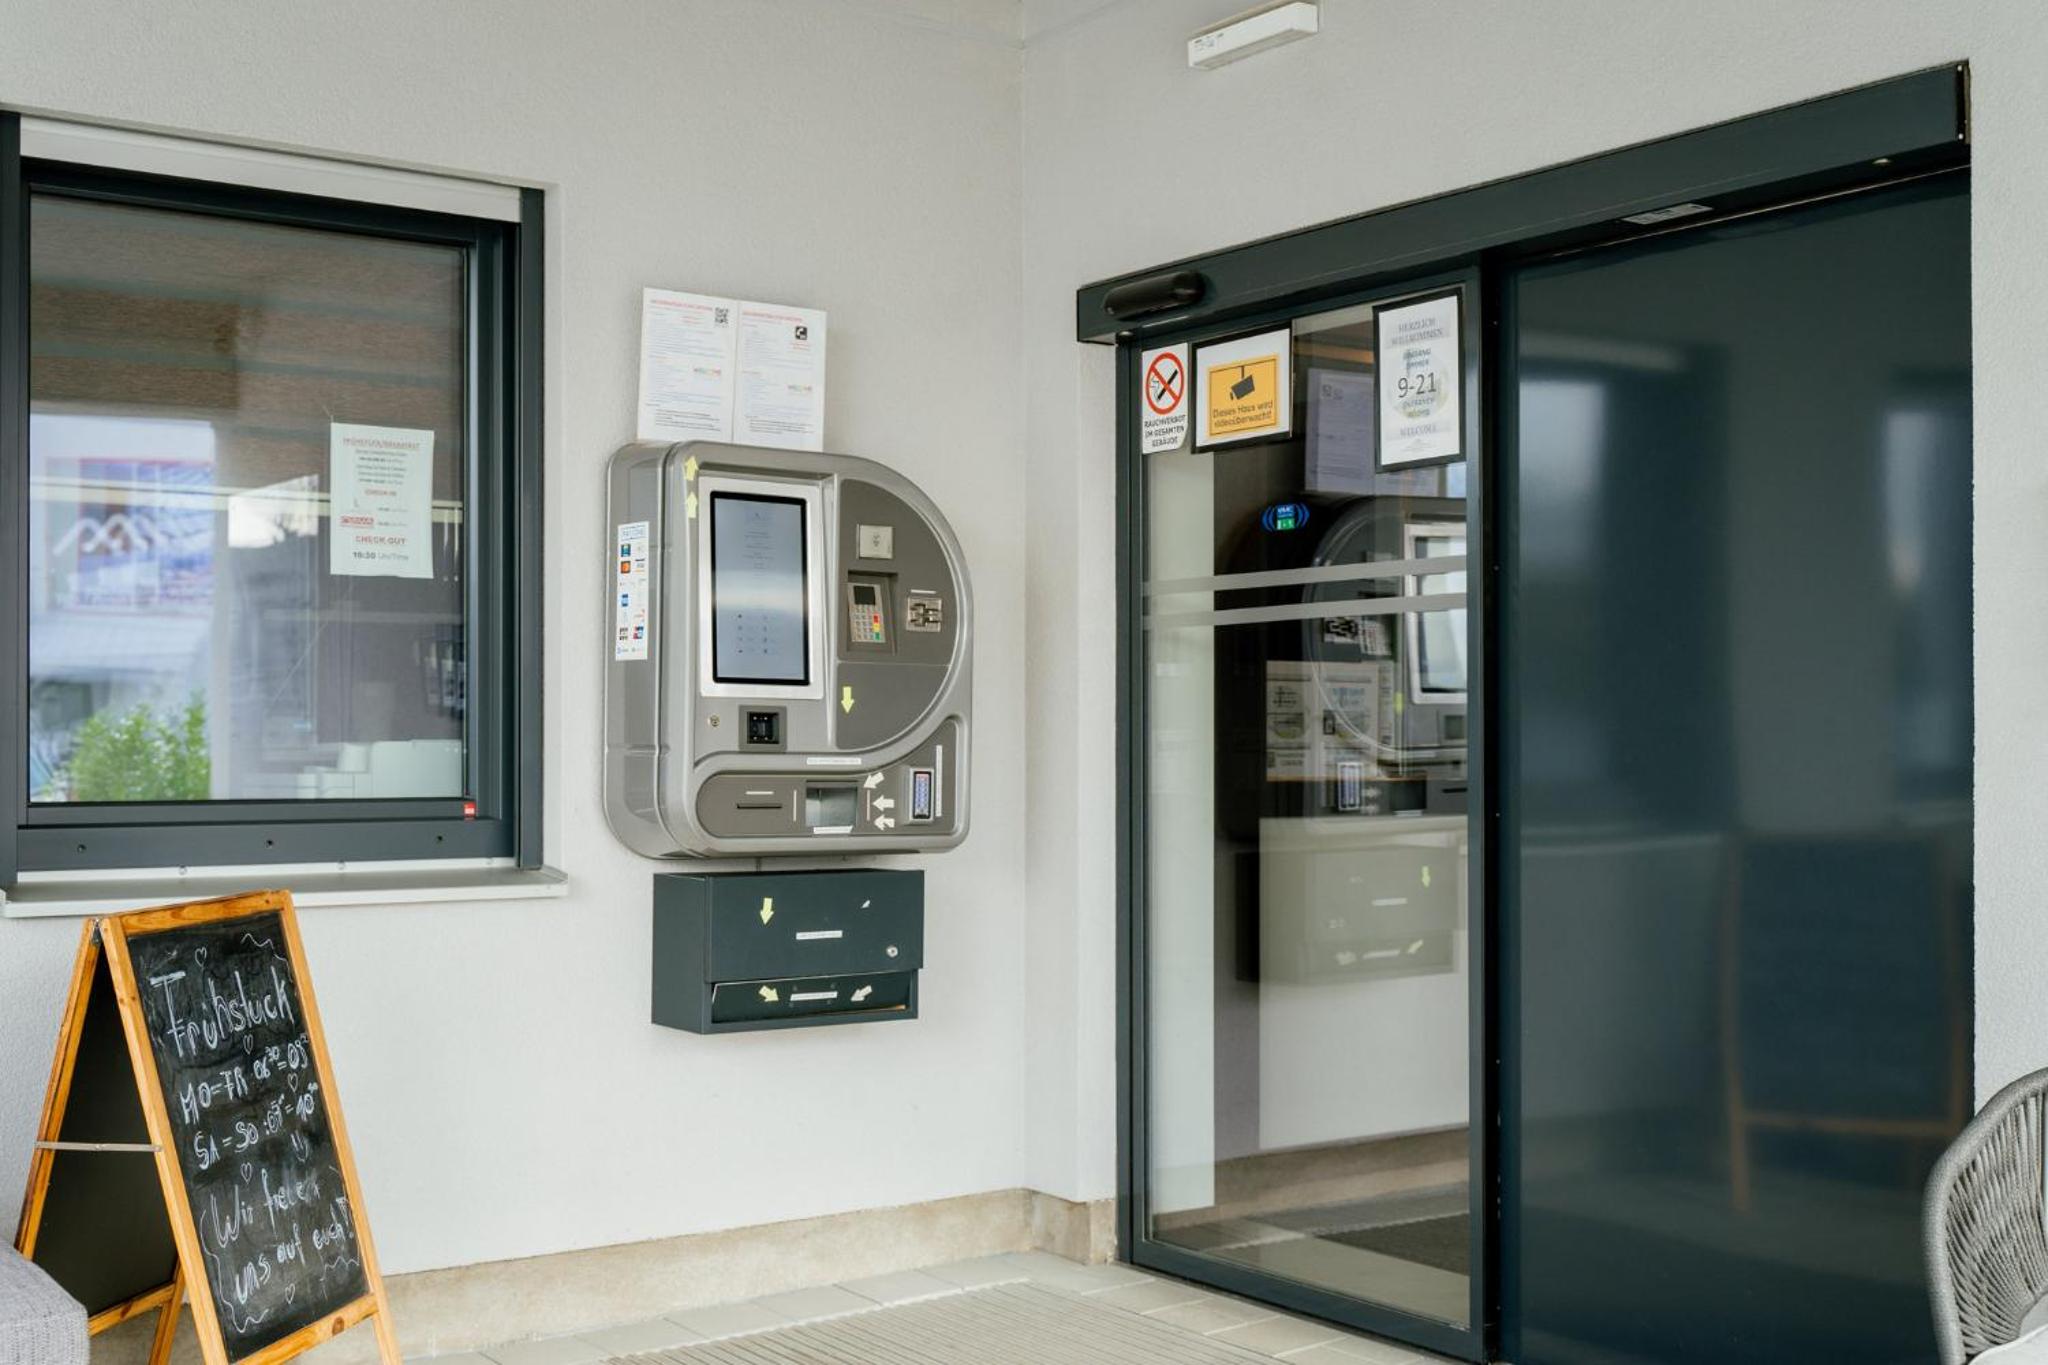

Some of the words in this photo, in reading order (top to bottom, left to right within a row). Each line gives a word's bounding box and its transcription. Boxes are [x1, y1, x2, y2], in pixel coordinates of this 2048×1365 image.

[1397, 371, 1438, 398] 9-21
[1213, 406, 1236, 419] Dieses
[1238, 402, 1255, 412] Haus
[1257, 399, 1273, 412] wird
[1144, 413, 1186, 427] RAUCHVERBOT
[1144, 430, 1155, 439] IM
[1155, 425, 1185, 436] GESAMTEN
[1152, 436, 1178, 447] GEBÄUDE
[276, 1221, 306, 1267] auf
